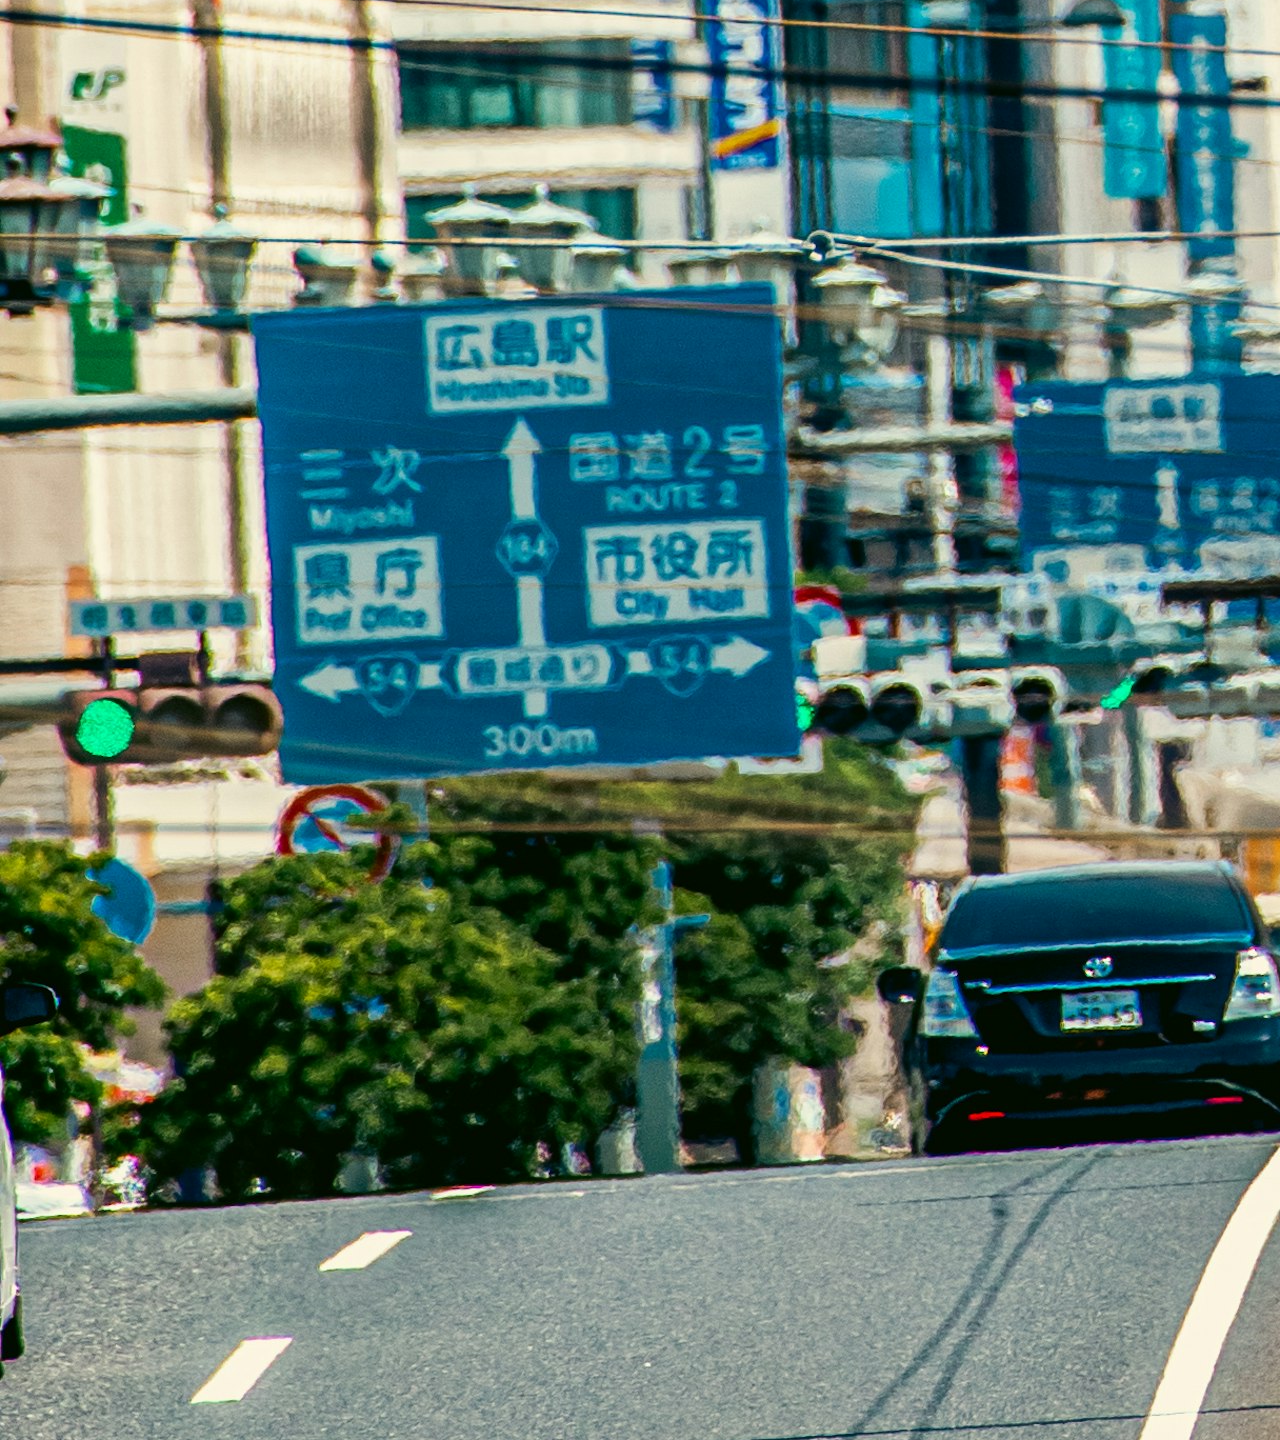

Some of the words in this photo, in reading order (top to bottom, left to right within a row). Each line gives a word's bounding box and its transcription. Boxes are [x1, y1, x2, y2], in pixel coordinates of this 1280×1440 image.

[435, 315, 598, 372] 広島駅
[300, 445, 425, 501] 三次
[568, 424, 767, 483] 国道2号
[605, 482, 707, 512] ROUTE
[717, 478, 740, 509] 2
[304, 547, 425, 599] 県庁
[593, 530, 757, 584] 市役所
[483, 723, 599, 759] 300m
